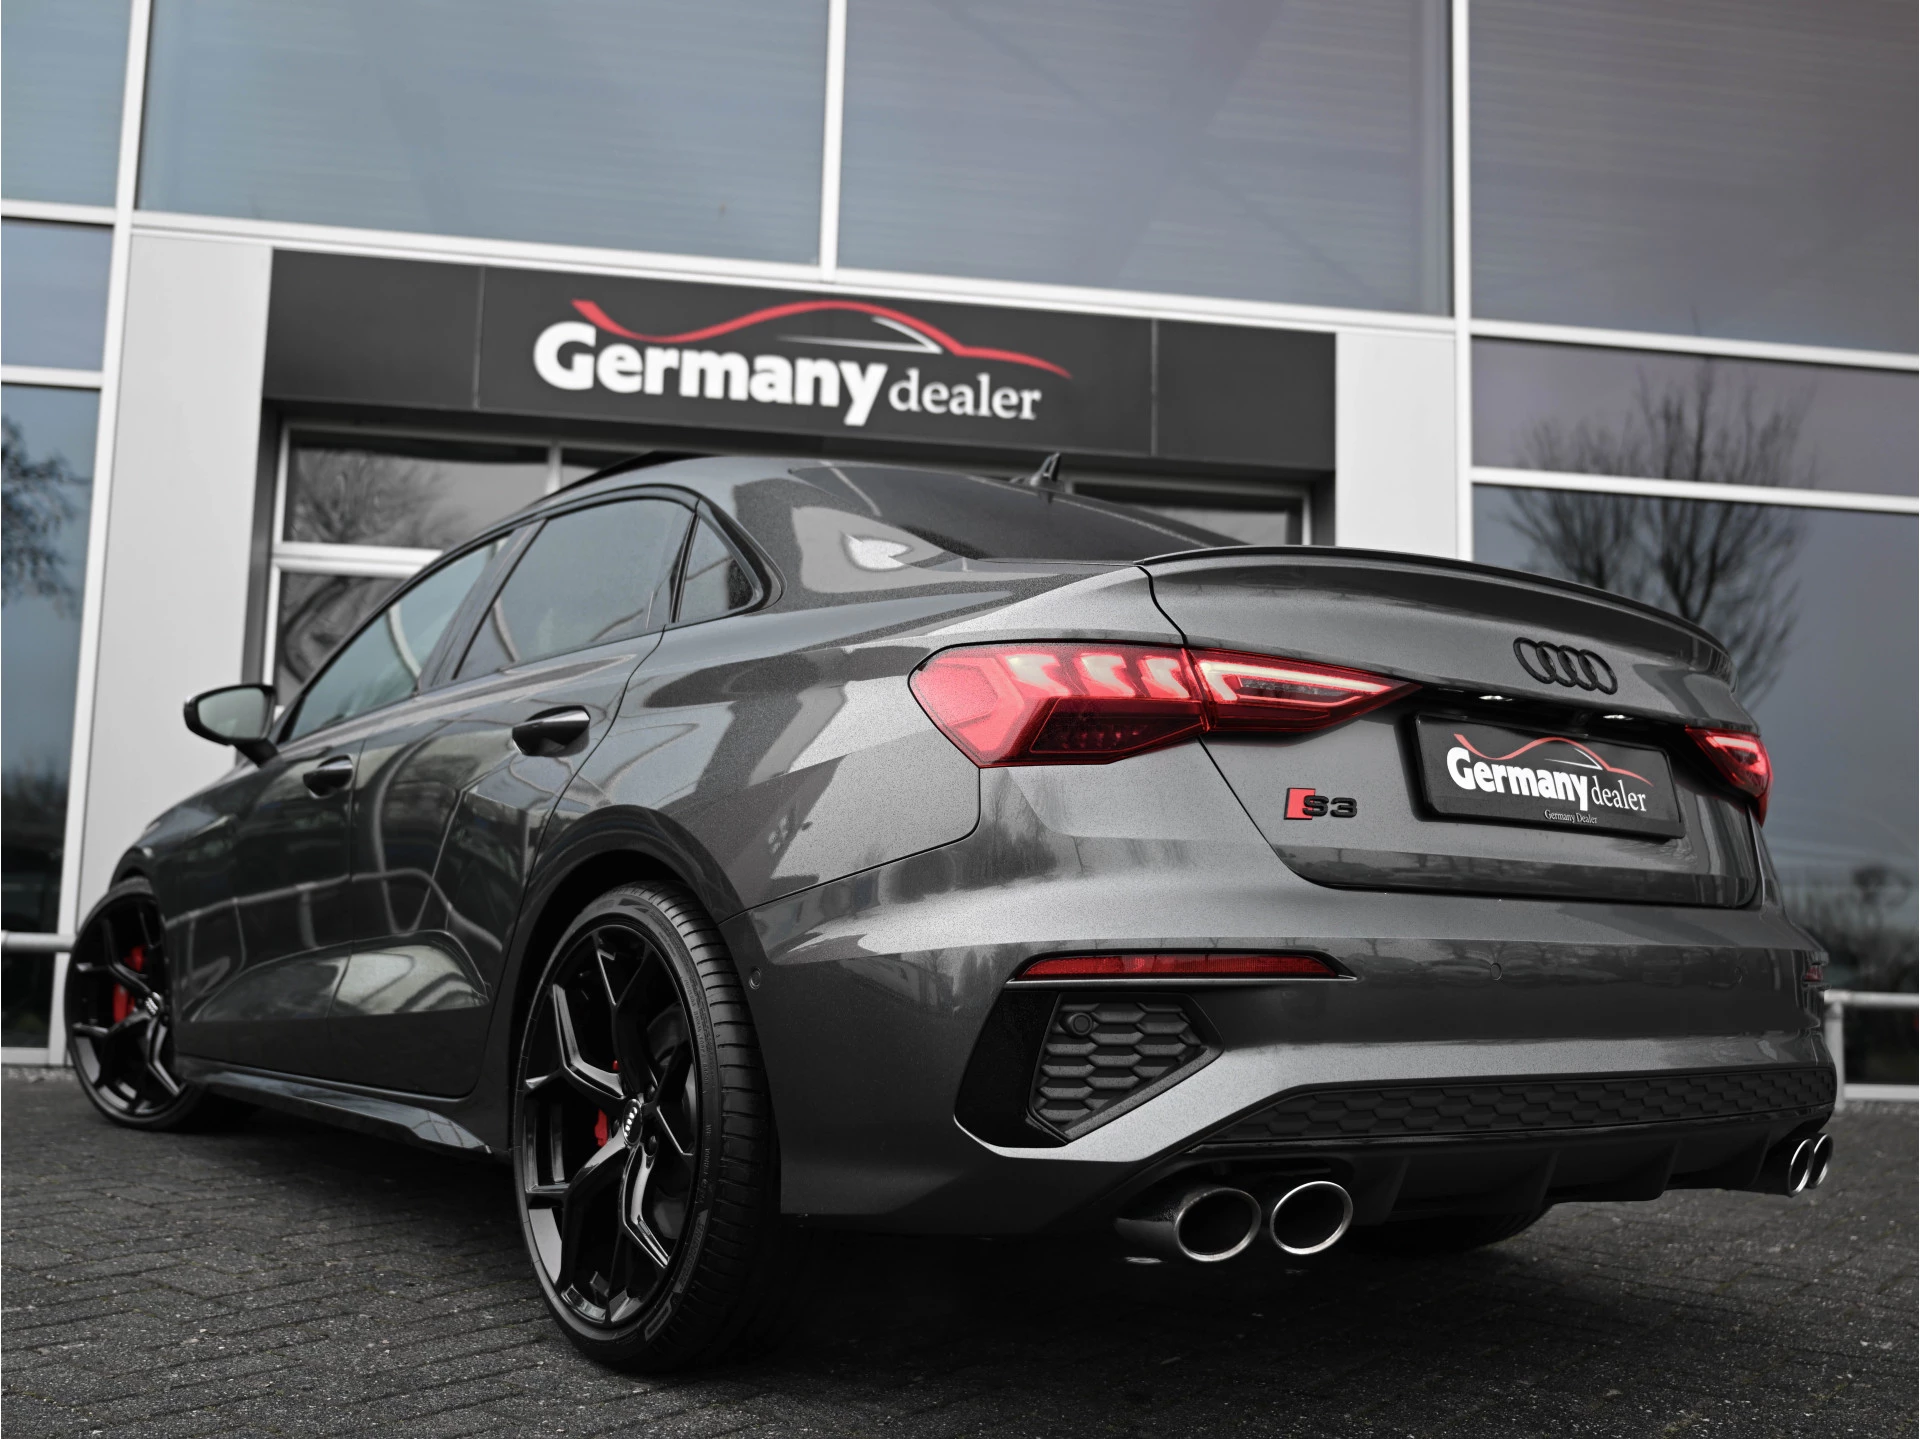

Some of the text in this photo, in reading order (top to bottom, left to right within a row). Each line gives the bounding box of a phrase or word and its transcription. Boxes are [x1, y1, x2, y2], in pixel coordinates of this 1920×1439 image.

[533, 320, 1042, 426] Germany dealer
[1446, 746, 1647, 812] Germany dealer
[1302, 794, 1358, 818] S3
[1544, 809, 1597, 824] Germany Dealer
